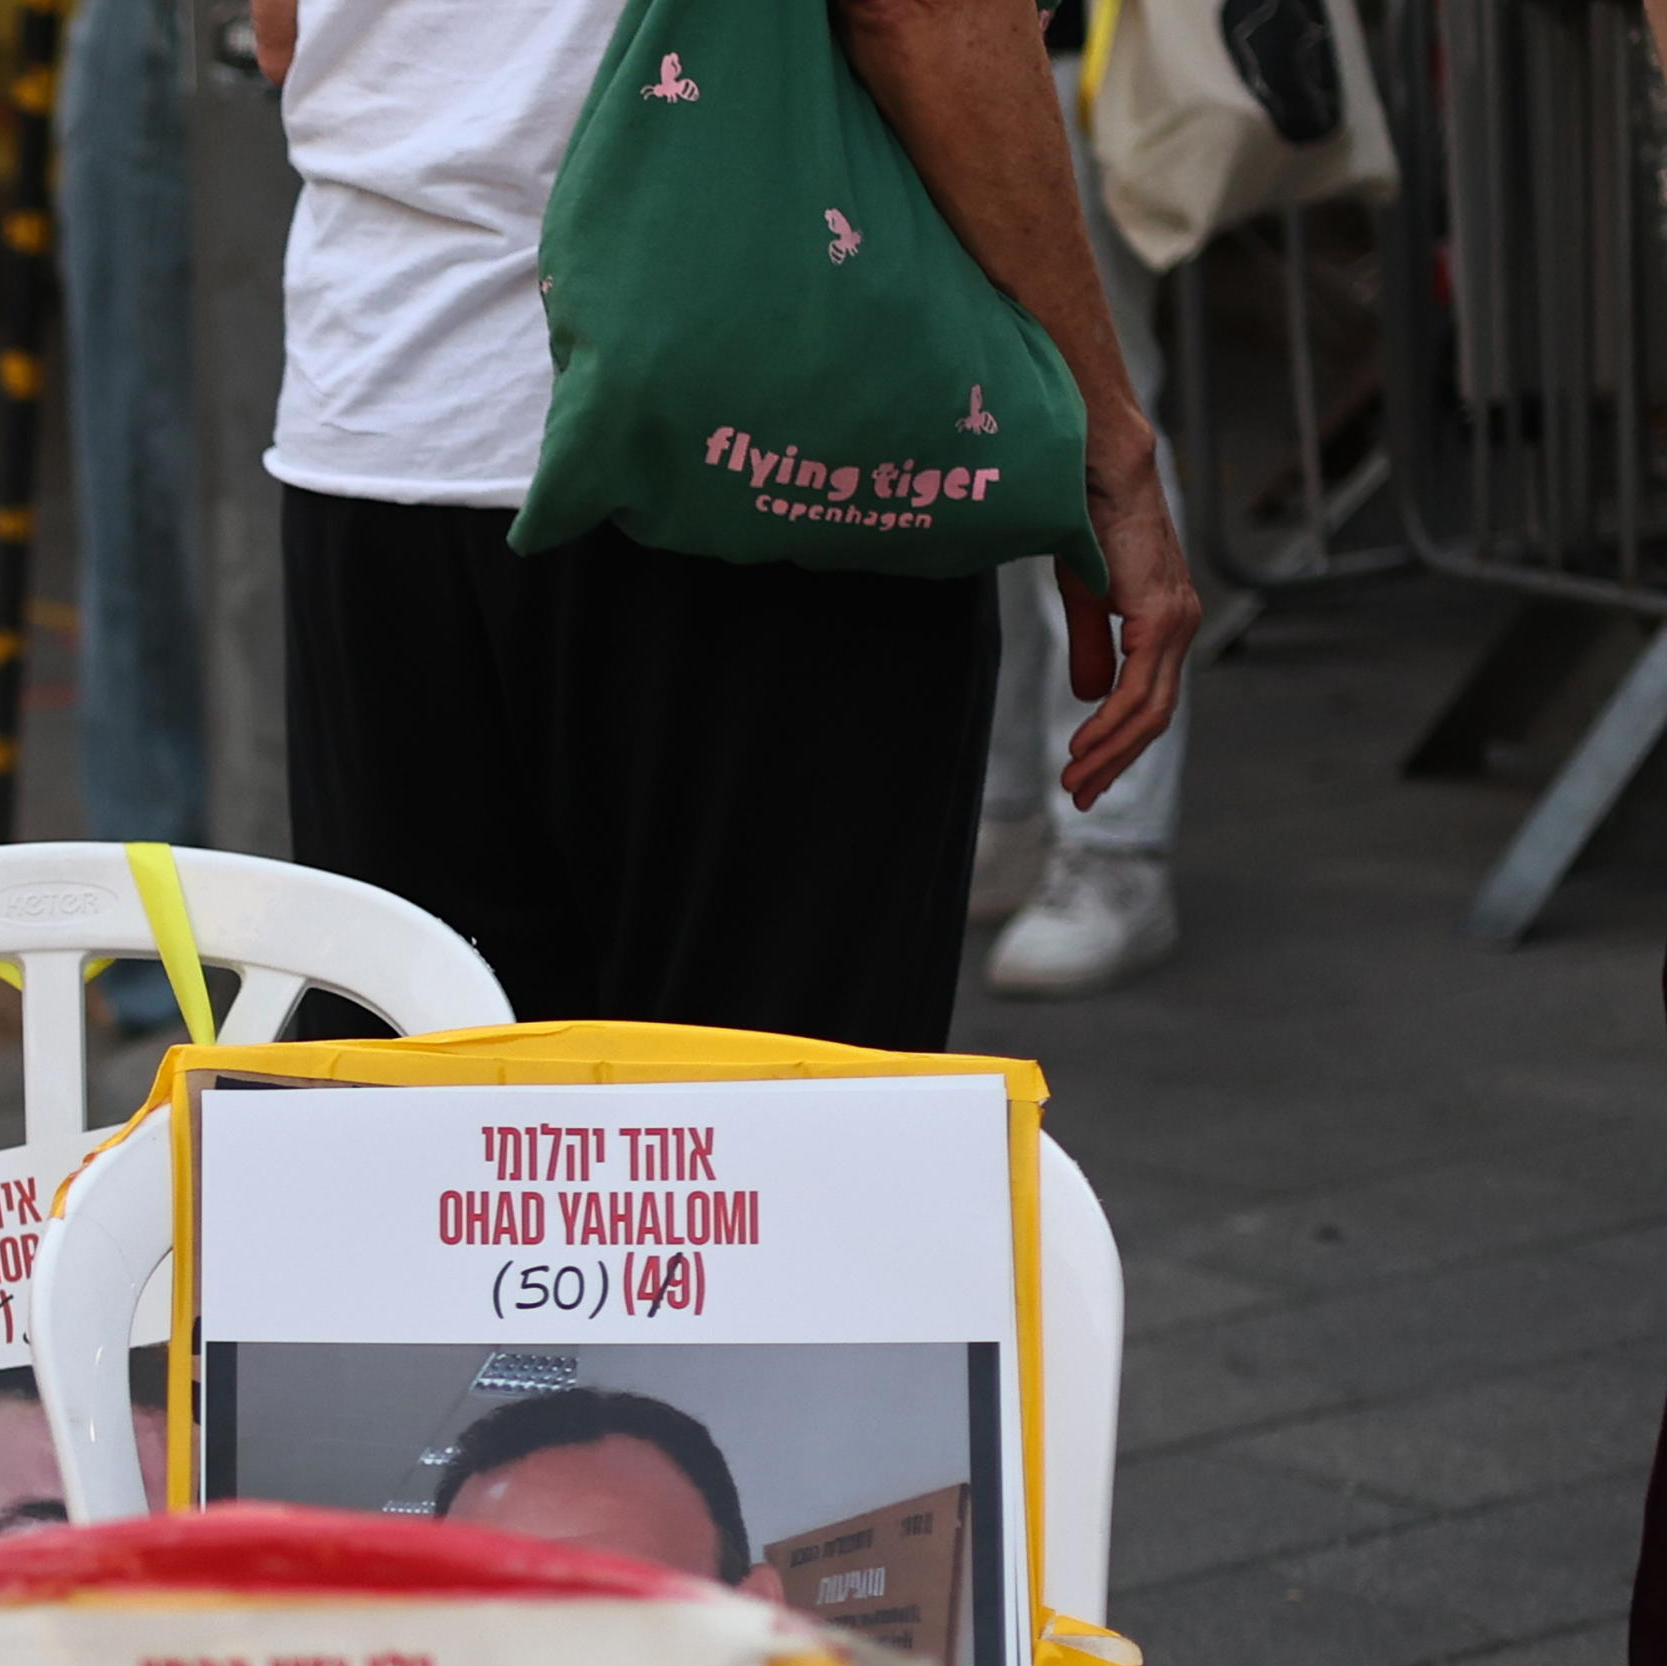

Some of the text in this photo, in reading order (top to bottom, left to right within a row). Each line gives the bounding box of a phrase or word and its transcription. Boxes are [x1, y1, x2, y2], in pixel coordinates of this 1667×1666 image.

[705, 426, 1000, 507] flying tiger
[481, 1122, 716, 1182] אוהד יהלומי
[438, 1190, 760, 1245] OHAD YAHALOMI
[491, 1259, 609, 1319] (50)
